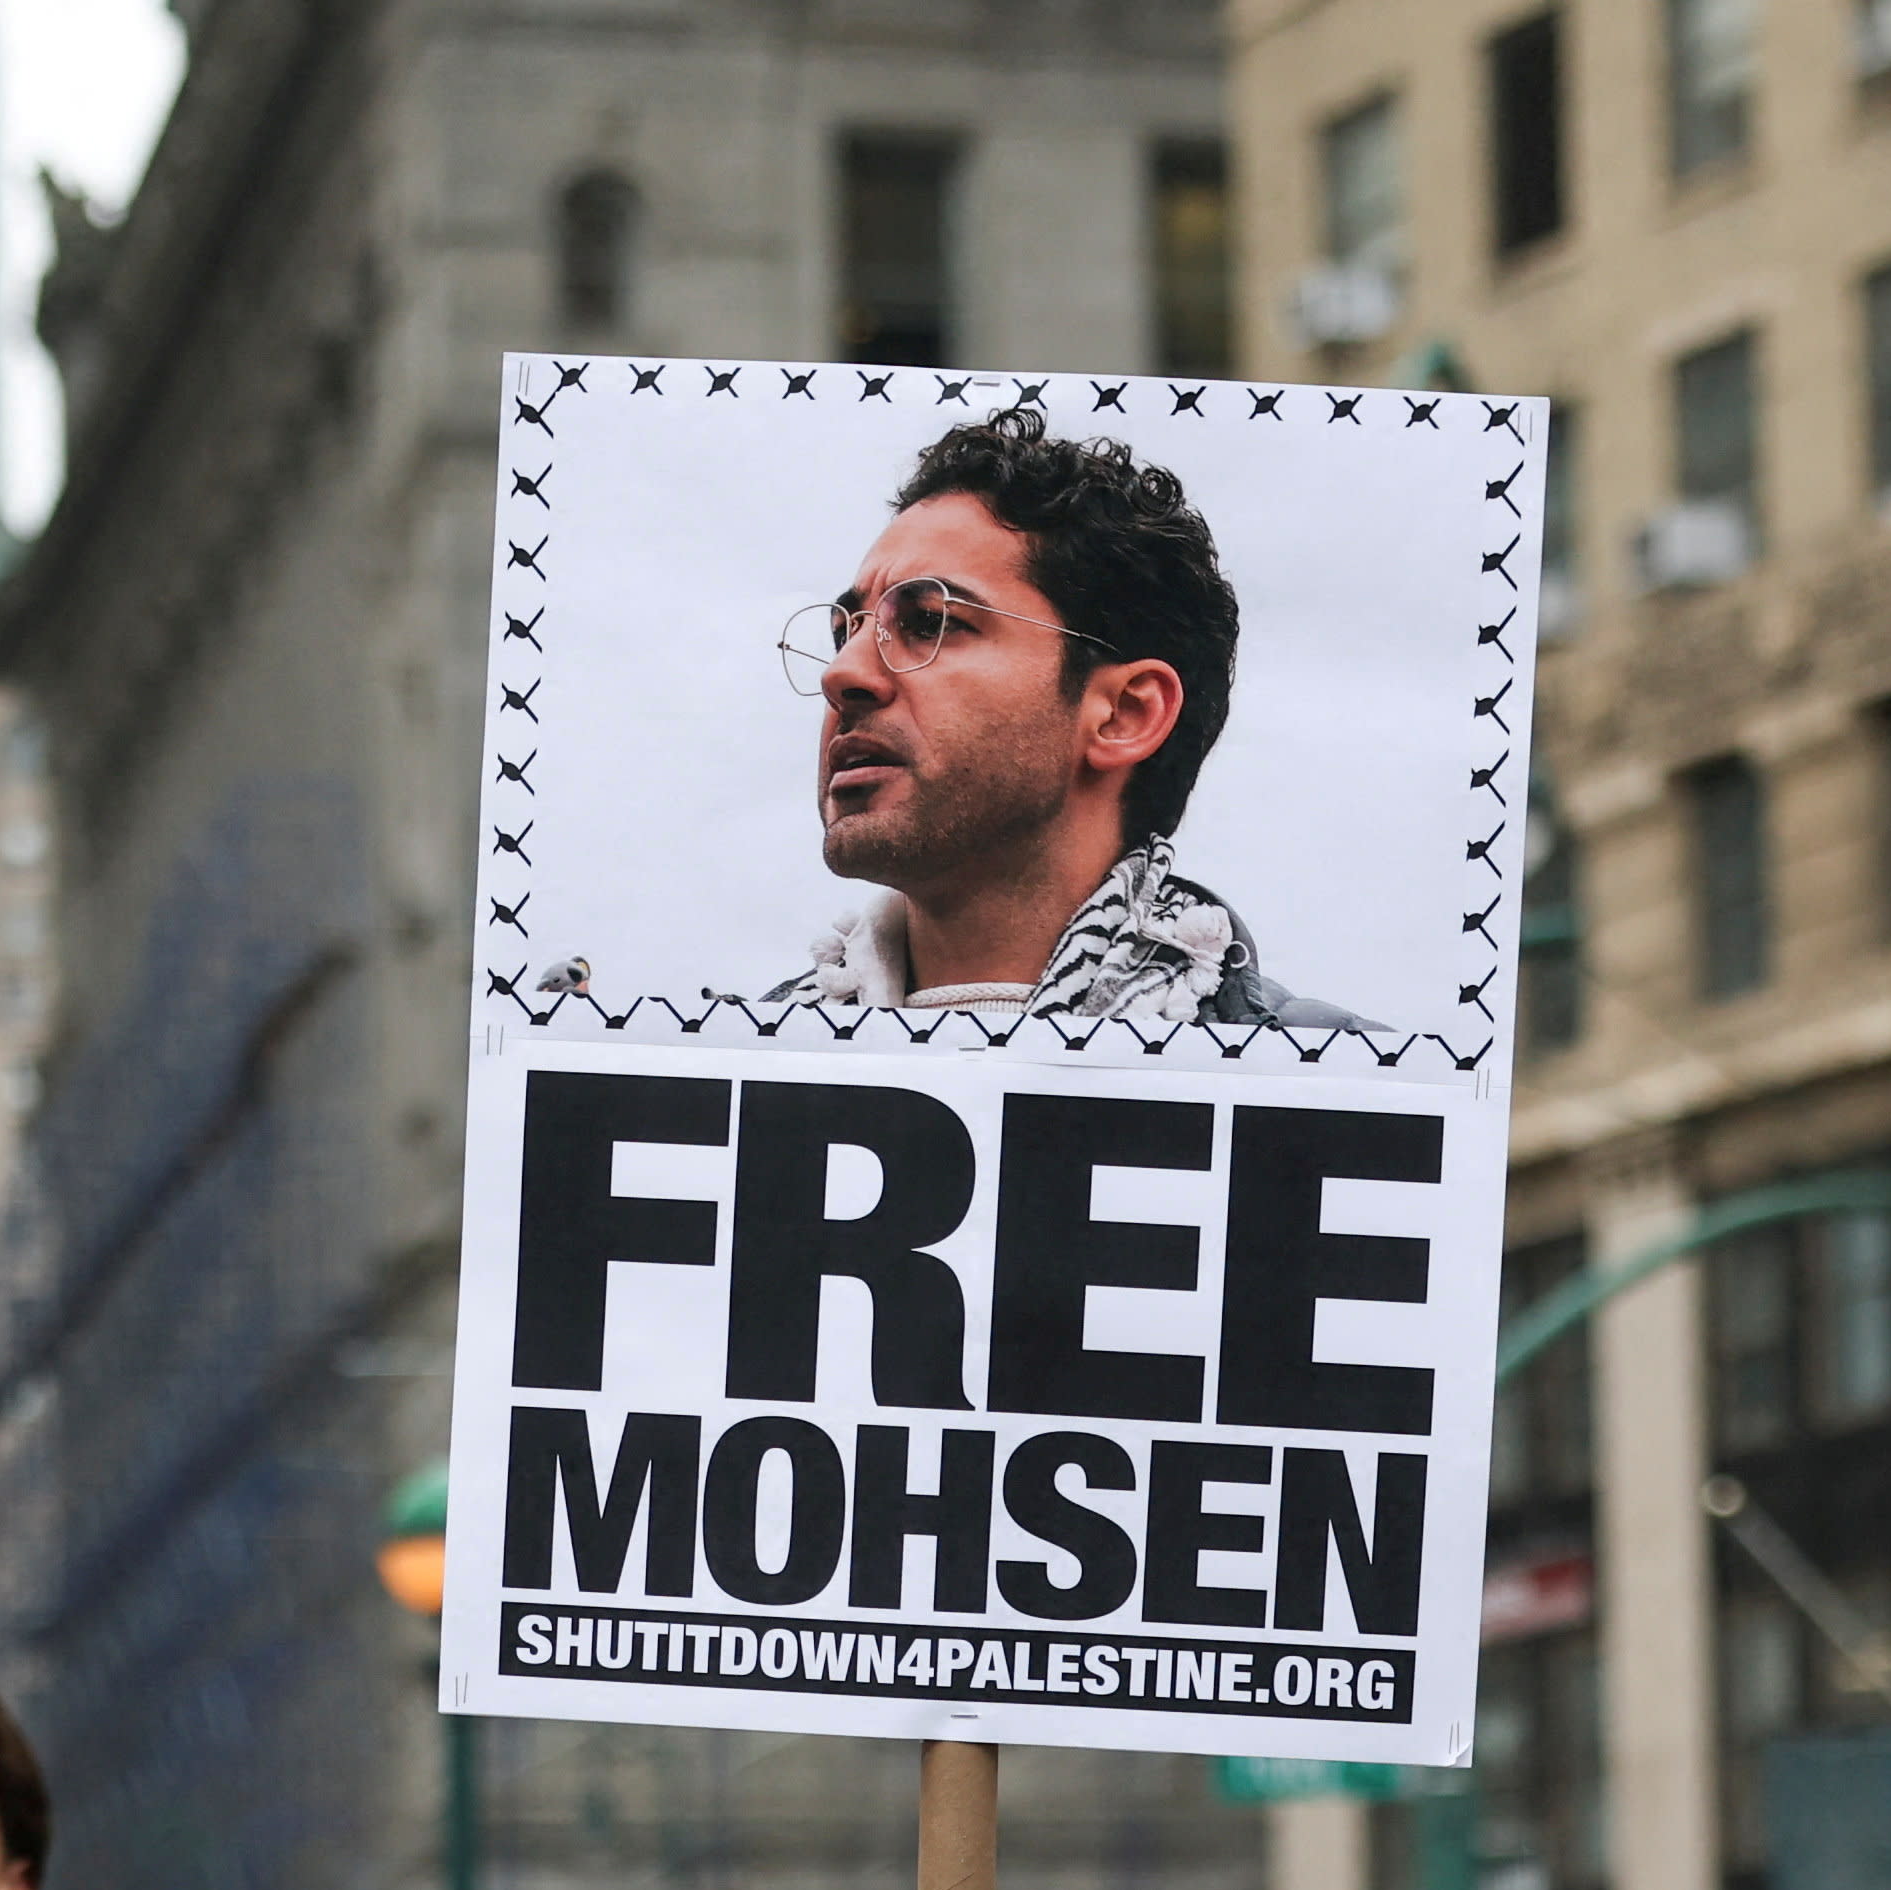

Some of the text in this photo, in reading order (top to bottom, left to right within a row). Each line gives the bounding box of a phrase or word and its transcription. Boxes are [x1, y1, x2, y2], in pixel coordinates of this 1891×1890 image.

[511, 1069, 1445, 1437] FREE
[501, 1405, 1429, 1637] MOHSEN
[515, 1613, 1396, 1711] SHUTITDOWN4PALESTINE.ORG
